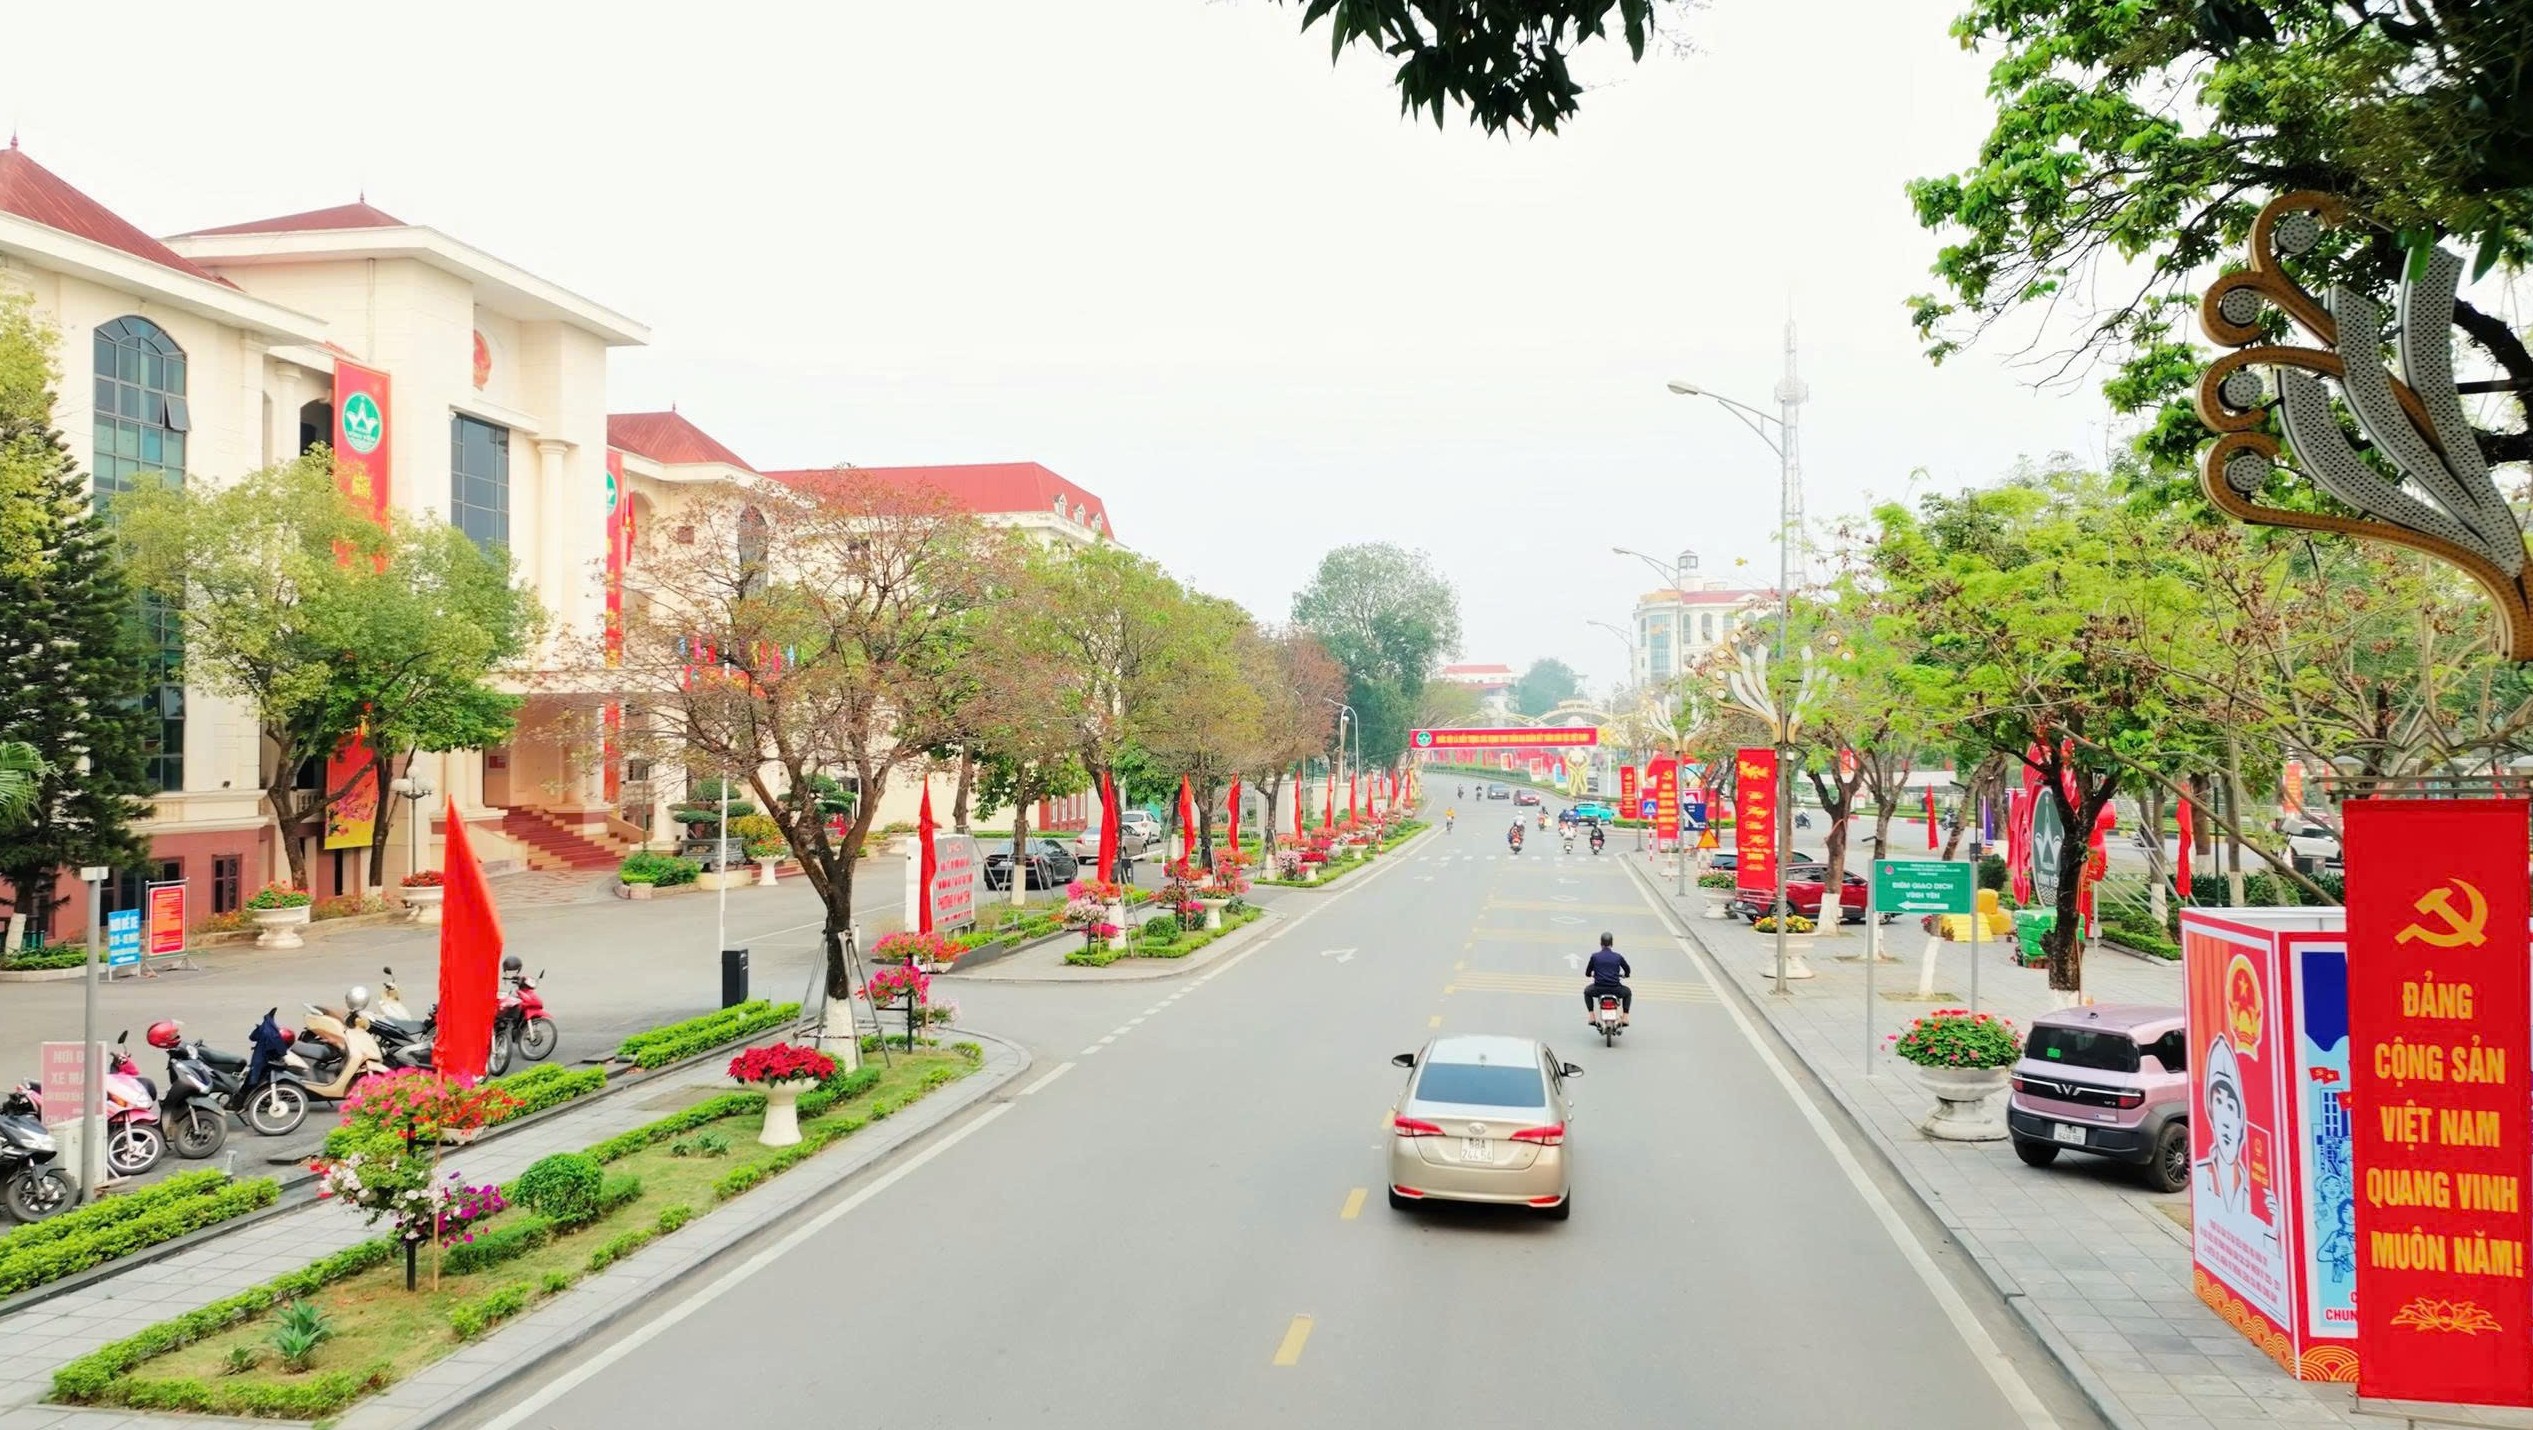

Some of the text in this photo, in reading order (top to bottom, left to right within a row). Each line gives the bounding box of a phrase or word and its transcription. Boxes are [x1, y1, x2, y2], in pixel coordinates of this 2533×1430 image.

[1911, 882, 1933, 890] GIAO
[2403, 971, 2472, 1019] ĐẢNG
[2375, 1035, 2504, 1087] CỘNG SẢN
[2381, 1100, 2499, 1150] VIỆT NAM
[2367, 1168, 2518, 1212] QUANG VINH
[2371, 1226, 2523, 1277] MUÔN NĂM!
